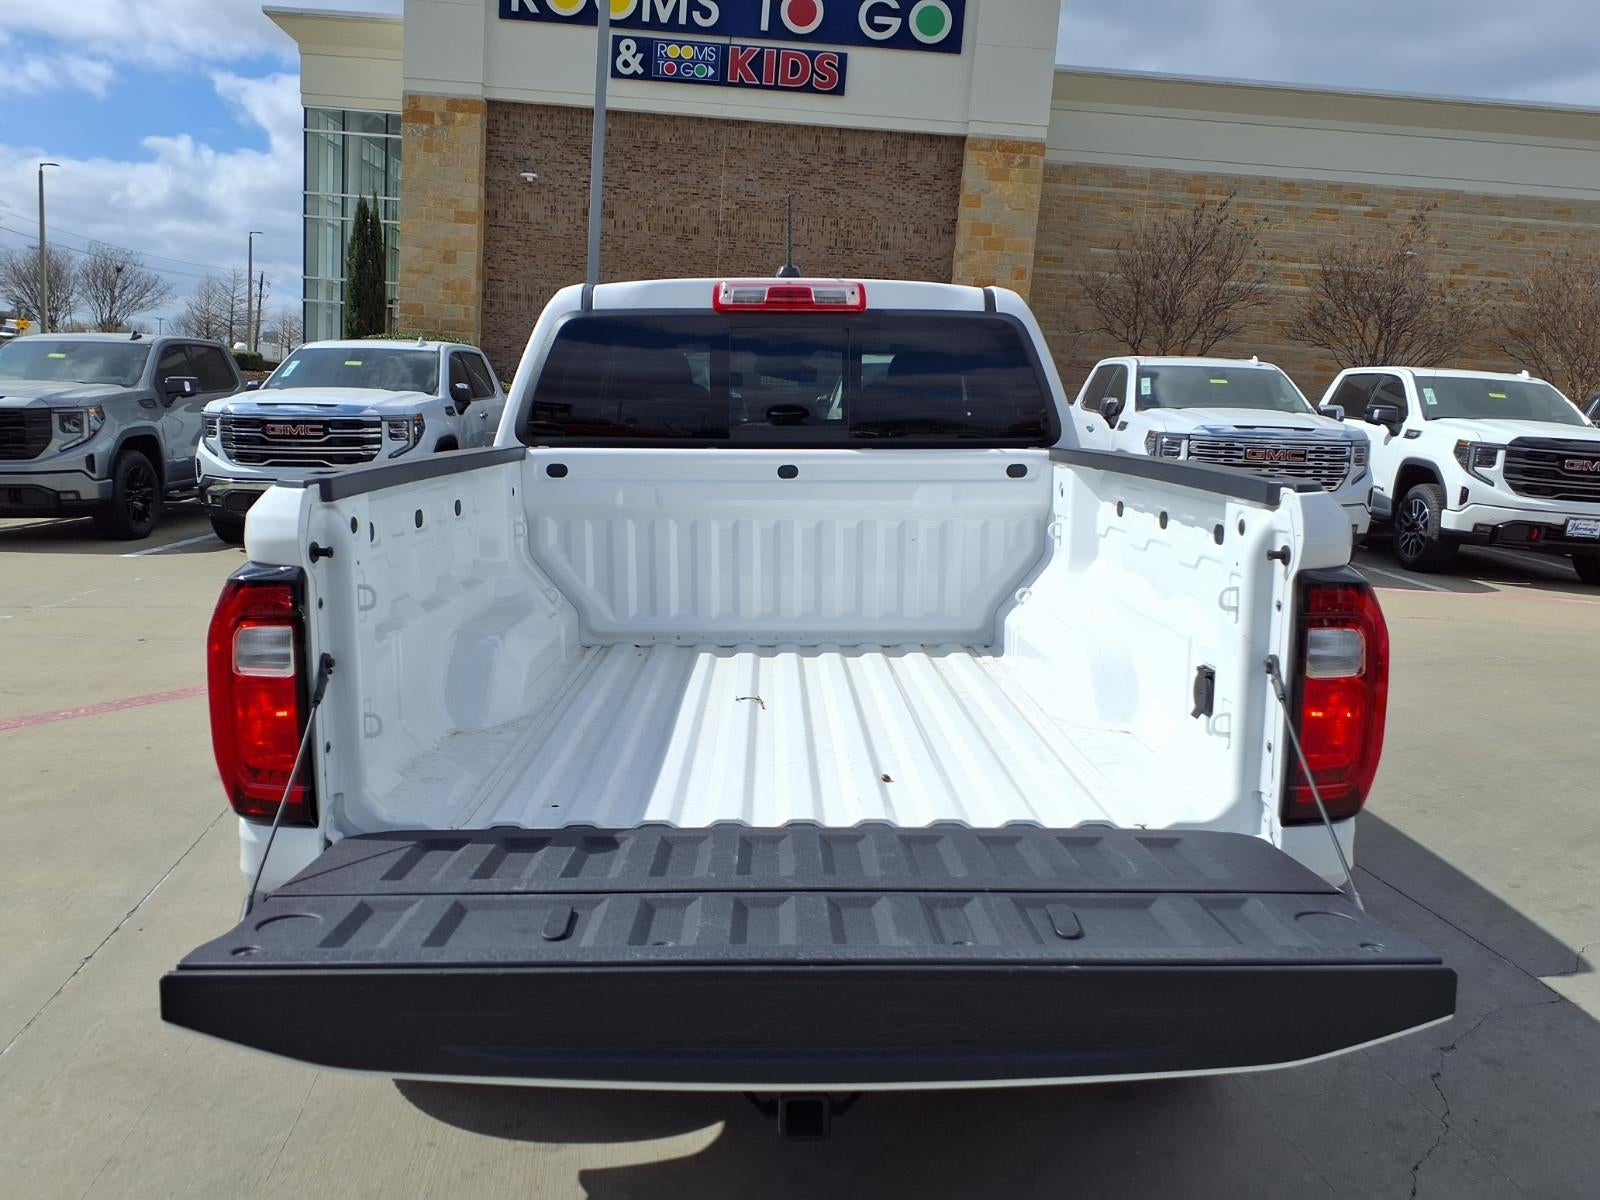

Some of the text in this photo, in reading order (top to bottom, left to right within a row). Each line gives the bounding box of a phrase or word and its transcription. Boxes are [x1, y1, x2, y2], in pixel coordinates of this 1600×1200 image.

[858, 0, 953, 44] GO
[616, 38, 644, 75] &
[657, 43, 716, 62] ROOMS
[657, 60, 708, 78] TO GO
[727, 46, 839, 91] KIDS
[266, 424, 324, 436] GMC
[1246, 448, 1306, 463] GMC
